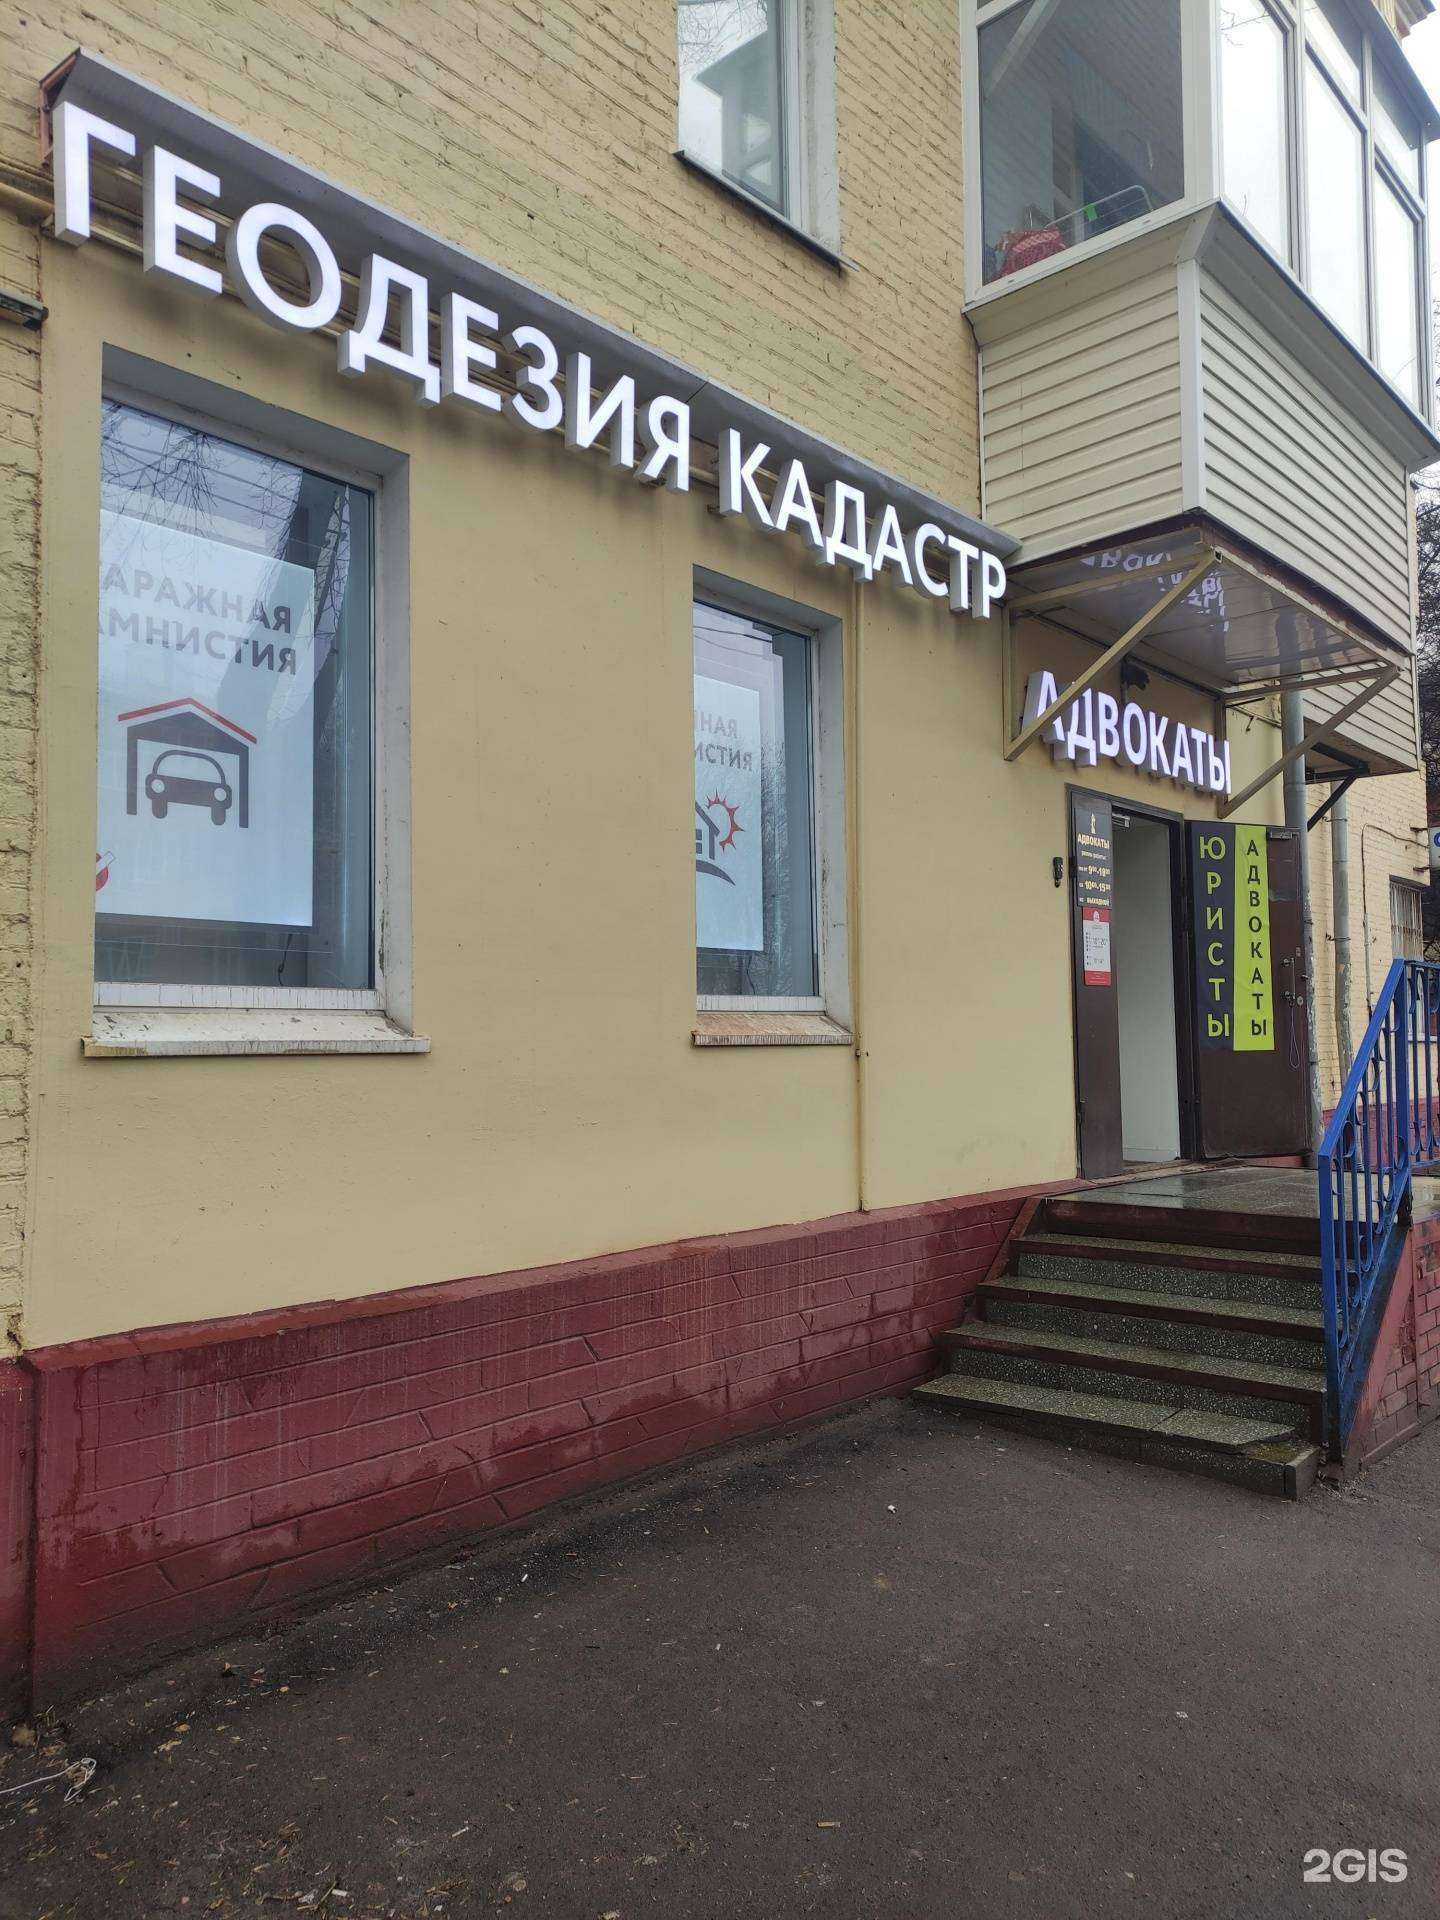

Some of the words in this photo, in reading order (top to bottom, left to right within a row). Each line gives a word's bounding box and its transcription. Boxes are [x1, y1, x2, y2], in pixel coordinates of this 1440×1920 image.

[53, 100, 691, 493] ГЕОДЕЗИЯ
[719, 427, 1007, 619] КАДАСТР
[98, 607, 296, 675] МНИСТИЯ
[695, 709, 738, 739] НАЯ
[1024, 670, 1232, 795] АДВОКАТЫ
[1077, 832, 1110, 849] АДВОКАТЫ
[1200, 836, 1231, 1038] ЮРИСТЫ
[1246, 839, 1268, 1036] АДВОКАТЫ
